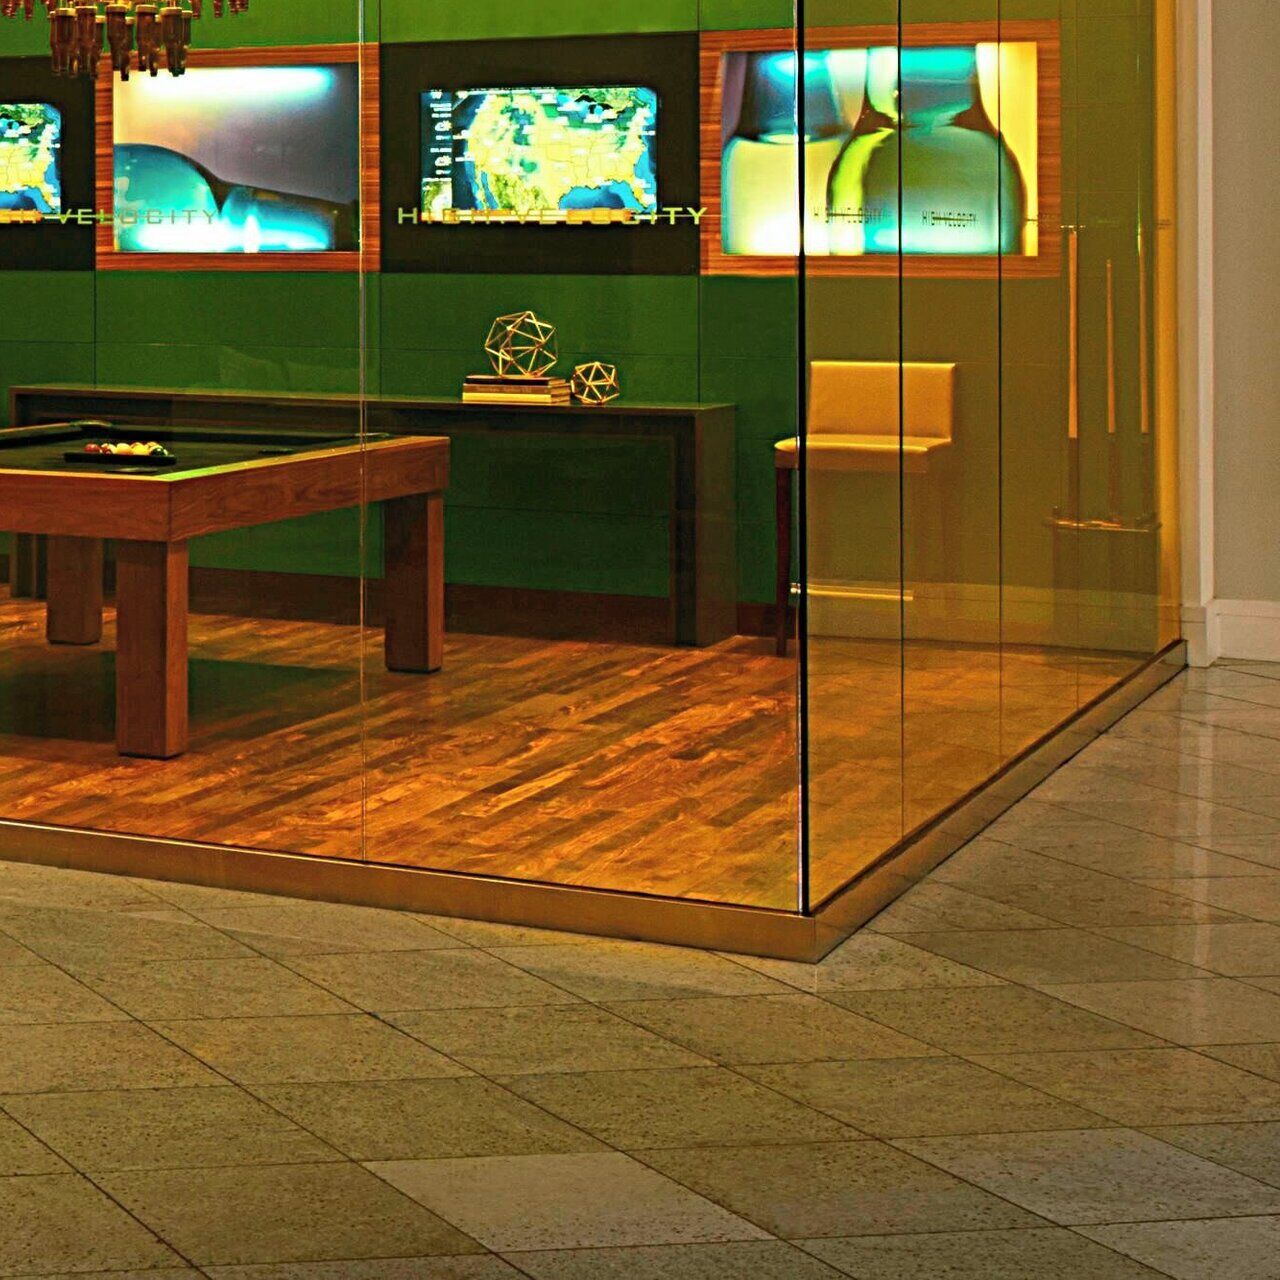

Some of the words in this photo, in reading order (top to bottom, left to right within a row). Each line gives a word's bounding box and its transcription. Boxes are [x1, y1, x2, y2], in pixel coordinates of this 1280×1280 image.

[57, 208, 219, 225] VELOCITY
[398, 207, 490, 225] HIGH
[513, 206, 707, 225] VELOCITY
